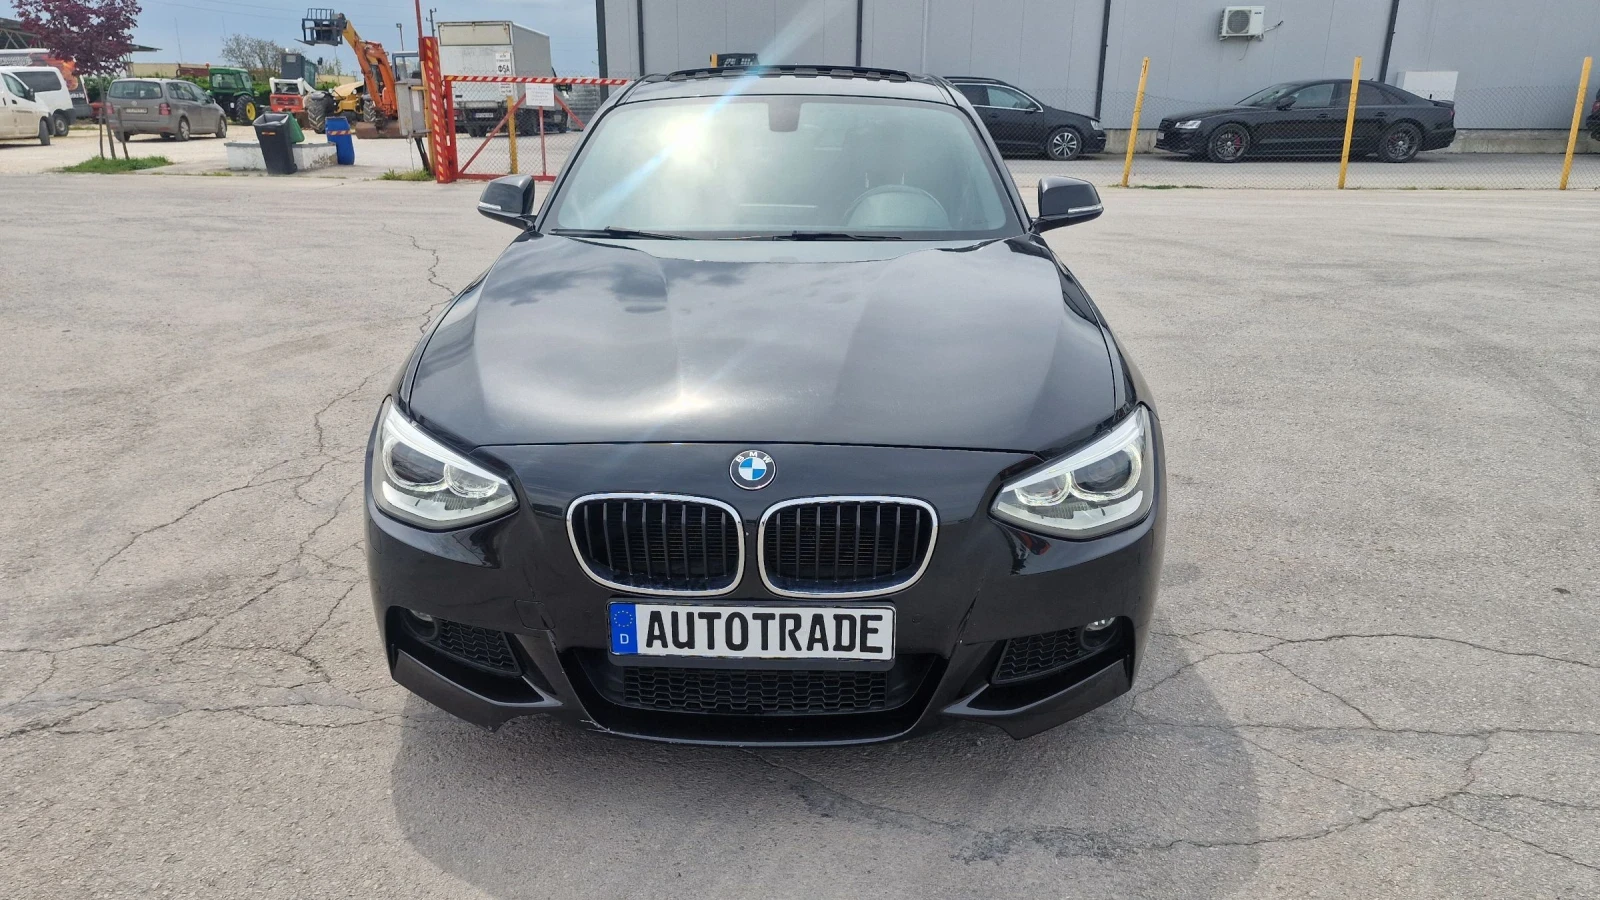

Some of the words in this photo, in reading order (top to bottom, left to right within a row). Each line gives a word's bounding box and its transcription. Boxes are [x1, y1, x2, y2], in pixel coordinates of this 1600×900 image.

[735, 451, 773, 463] BMW
[646, 610, 884, 654] AUTOTRADE
[619, 633, 629, 644] D
